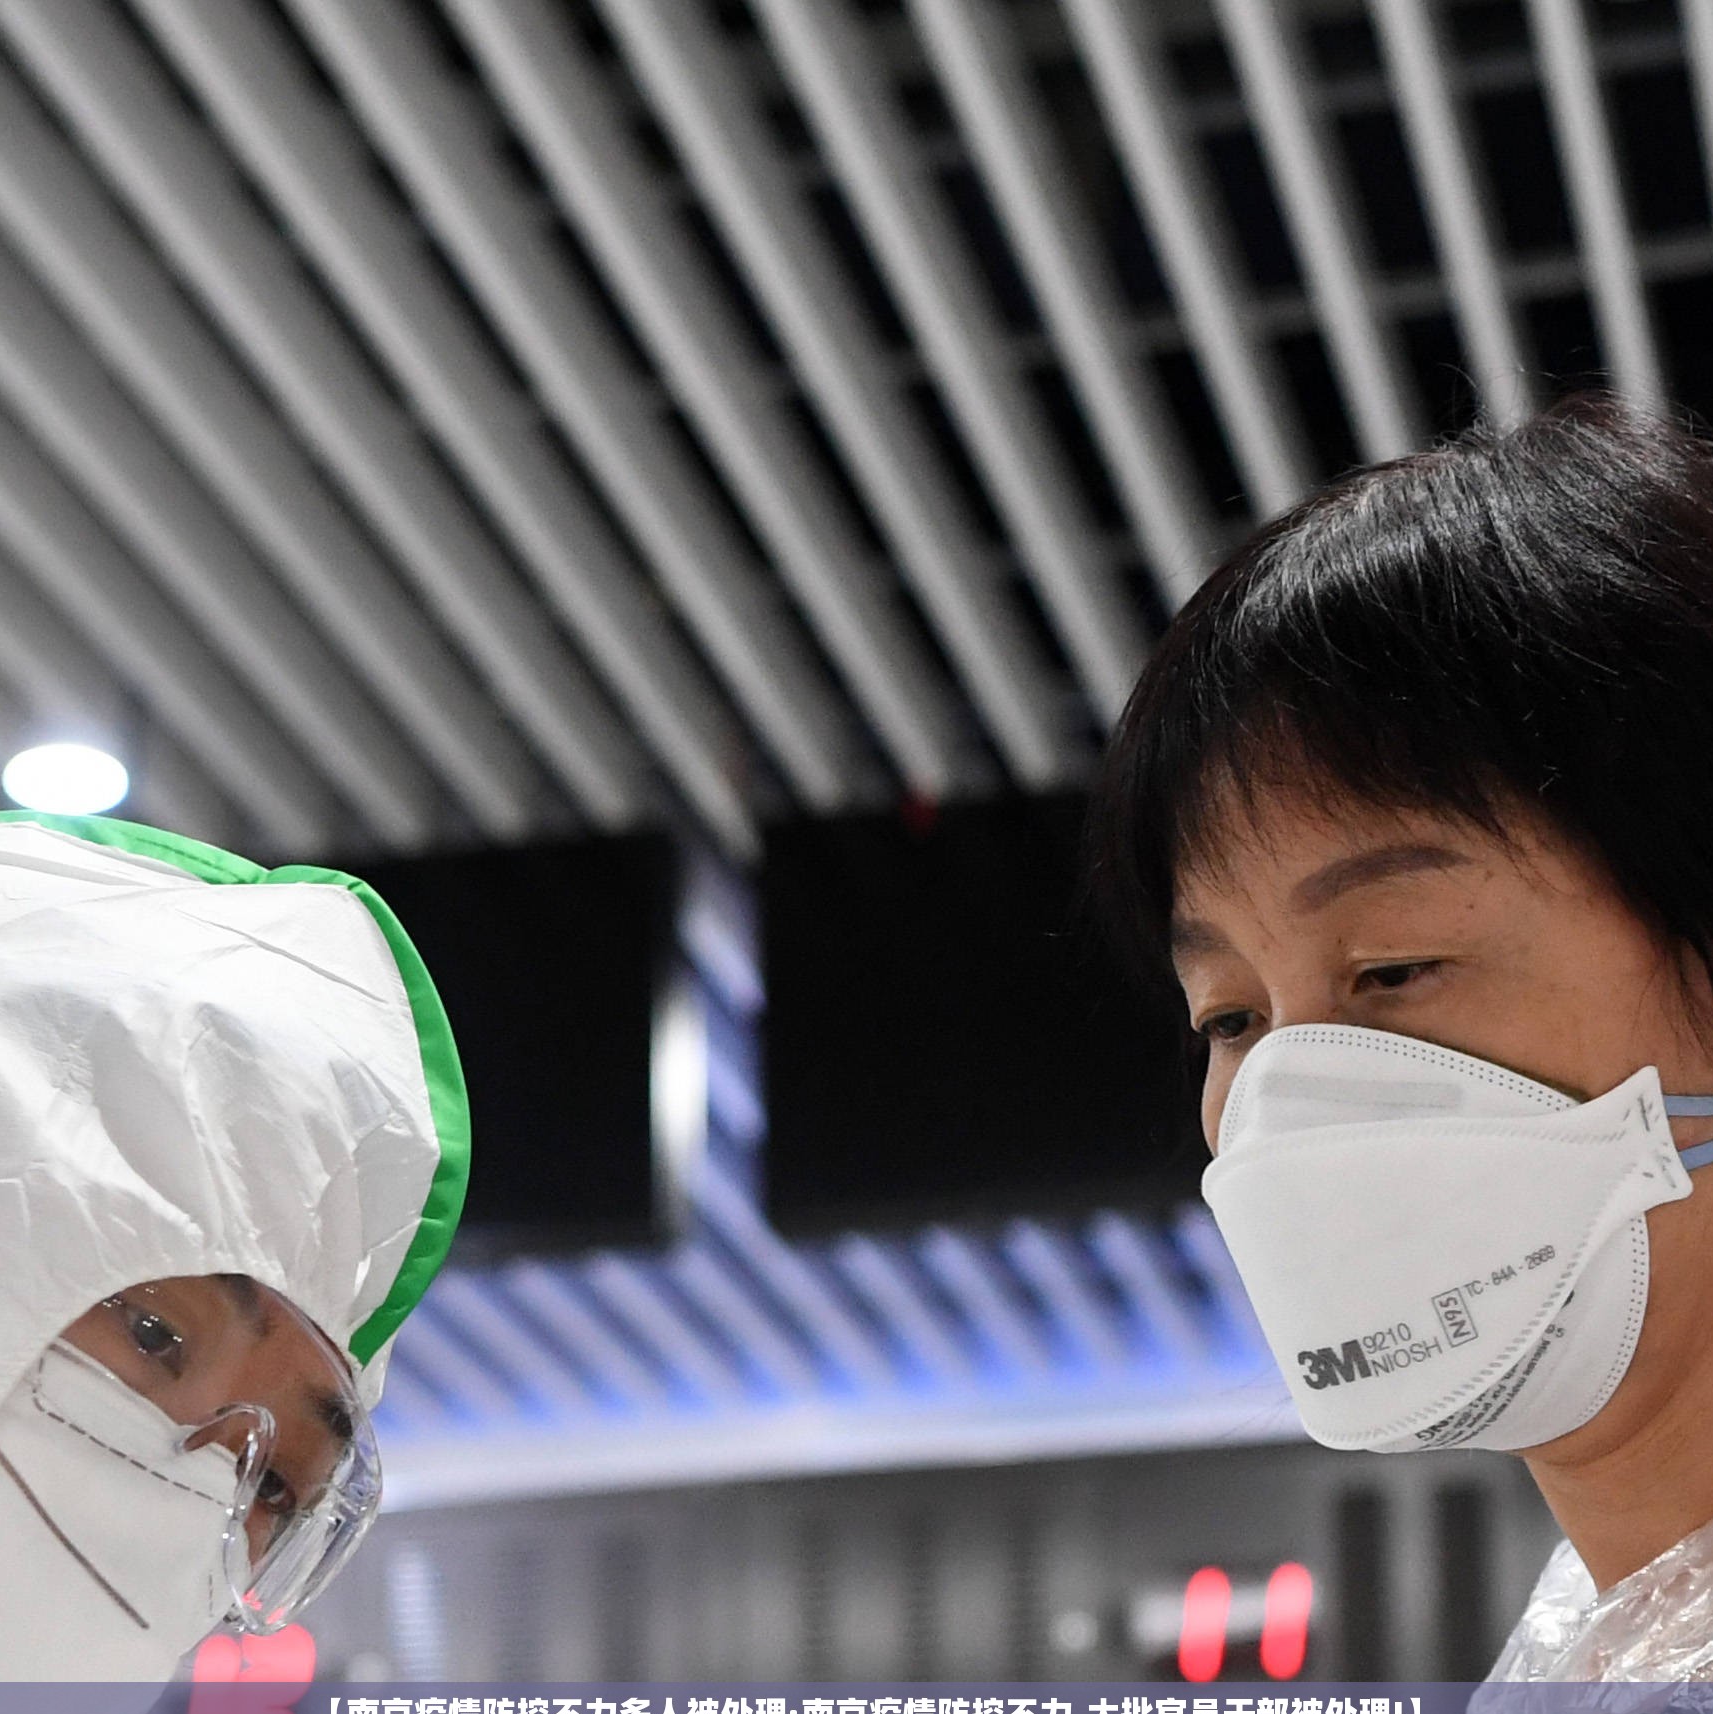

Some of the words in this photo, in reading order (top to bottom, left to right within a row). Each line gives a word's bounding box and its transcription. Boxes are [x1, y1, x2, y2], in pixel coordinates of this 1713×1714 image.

[1362, 1322, 1412, 1354] 9210
[1439, 1296, 1471, 1340] N95
[1297, 1339, 1372, 1390] 3M
[1370, 1336, 1443, 1377] NIOSH
